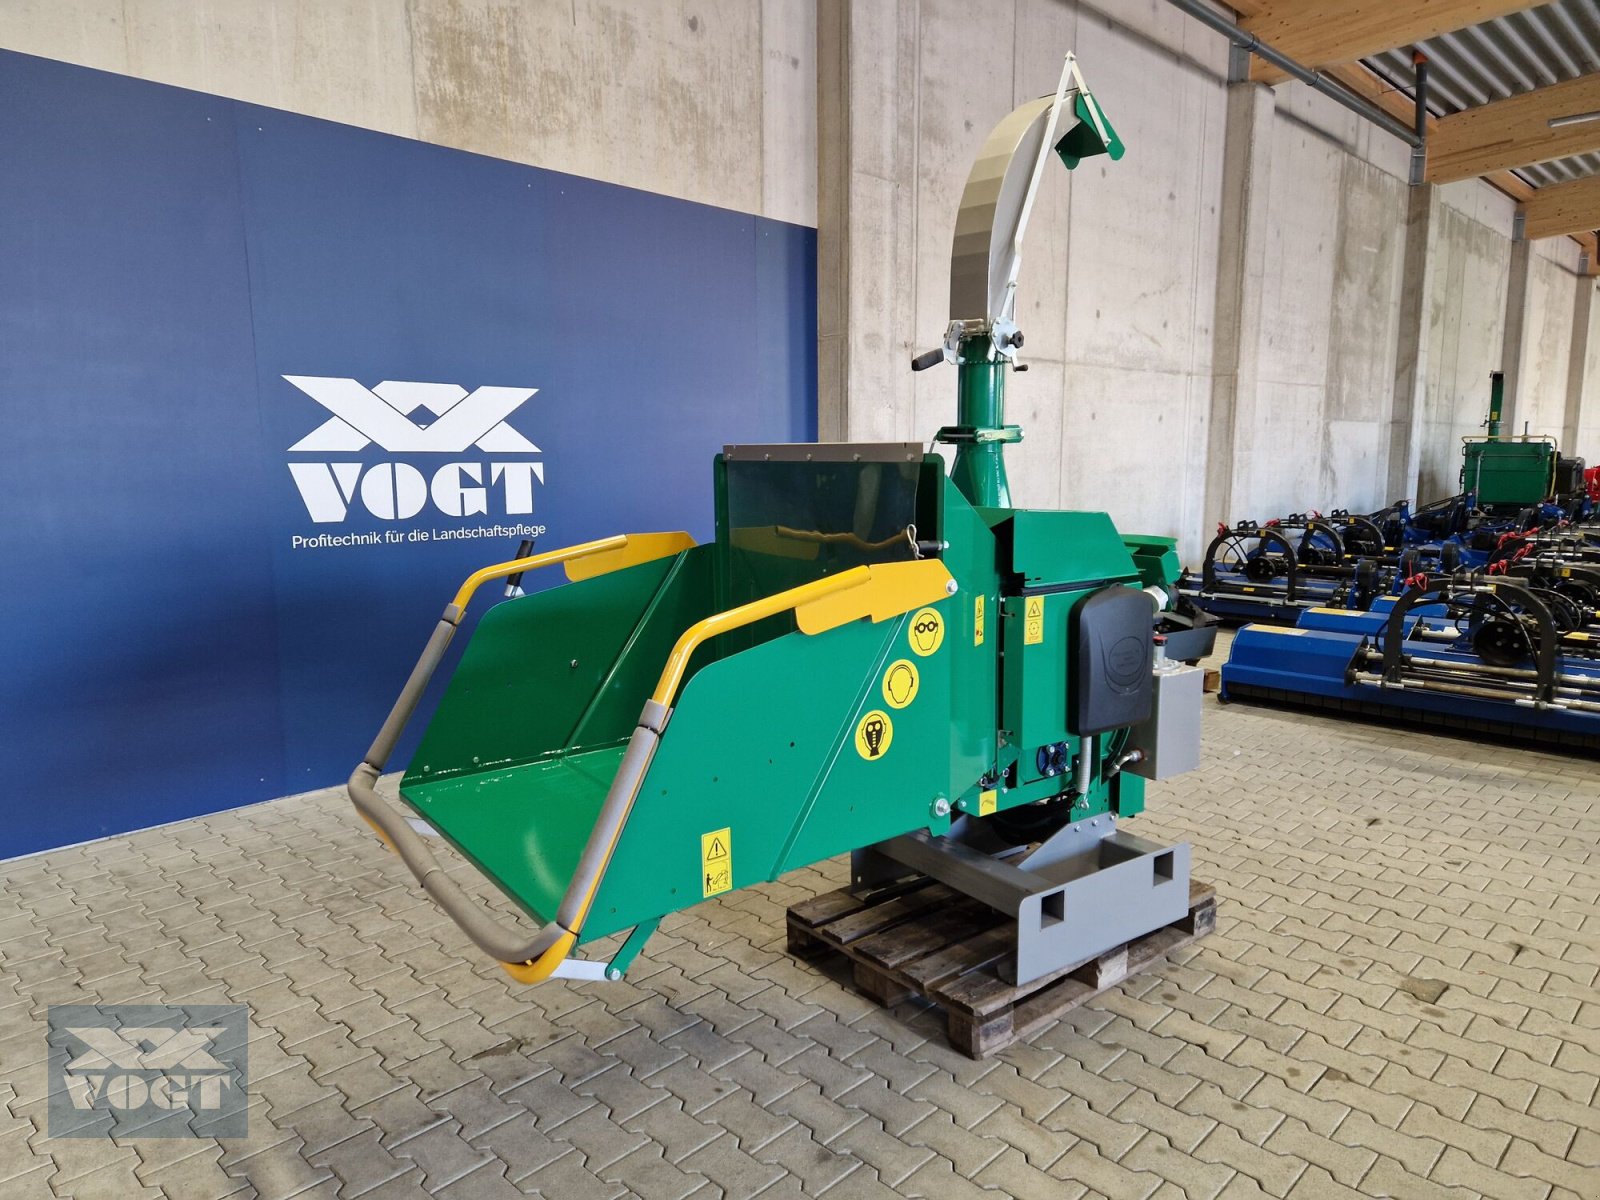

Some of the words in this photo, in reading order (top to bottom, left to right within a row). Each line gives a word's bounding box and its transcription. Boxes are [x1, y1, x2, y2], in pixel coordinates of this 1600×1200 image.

[287, 463, 545, 523] VOGT
[292, 531, 382, 549] Profitechnik
[385, 530, 405, 544] für
[408, 529, 429, 542] die
[432, 524, 546, 540] Landschaftspflege
